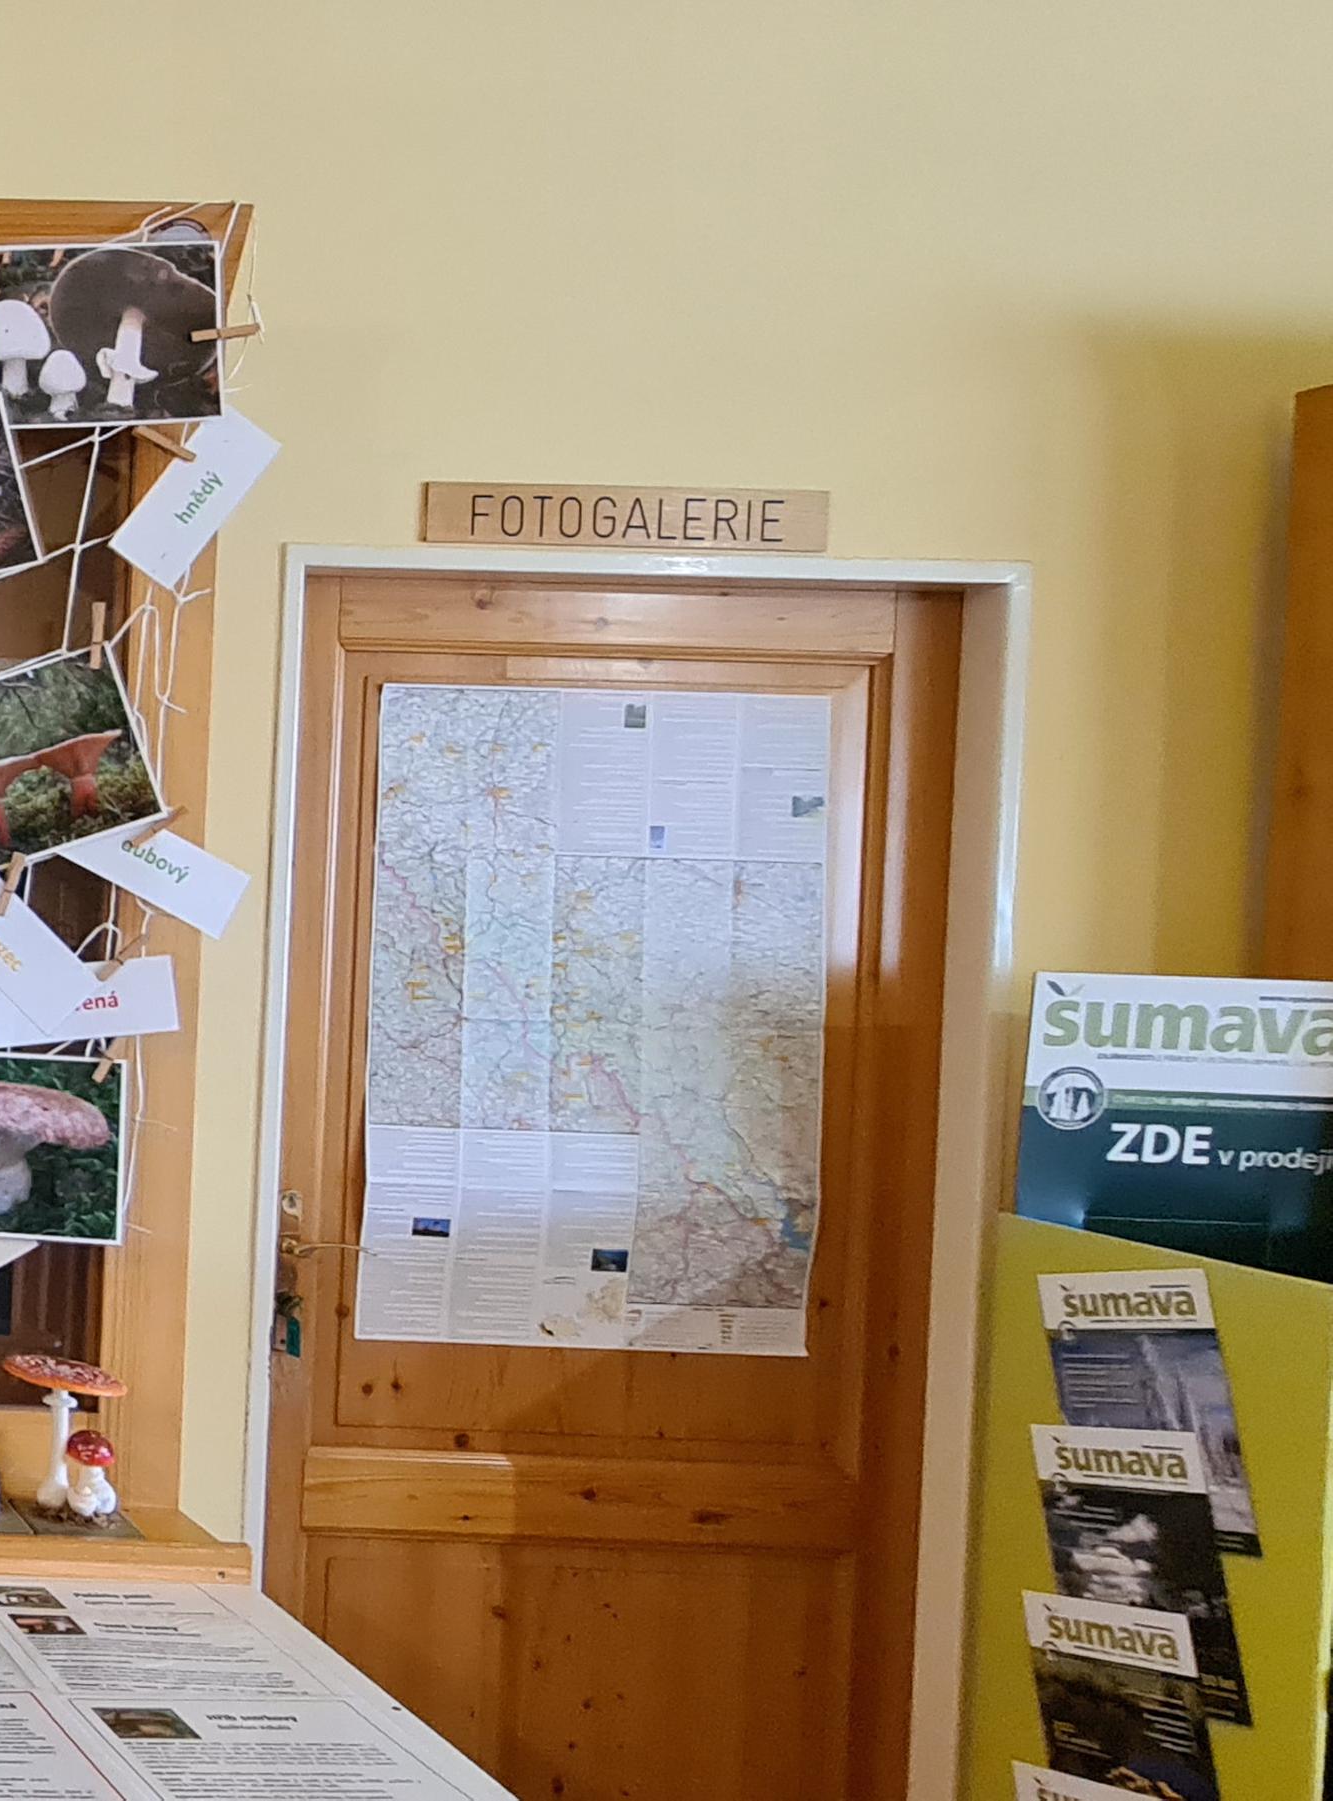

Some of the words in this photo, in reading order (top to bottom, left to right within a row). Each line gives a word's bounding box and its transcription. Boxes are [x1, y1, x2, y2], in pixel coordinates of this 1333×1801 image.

[172, 469, 225, 526] hnědý
[469, 494, 786, 544] FOTOGALERIE
[1042, 979, 1333, 1057] šumava
[1105, 1123, 1213, 1165] ZDE
[1218, 1150, 1235, 1166] v
[1059, 1283, 1197, 1318] šumava
[1052, 1435, 1188, 1481] šumava
[1042, 1603, 1179, 1662] šumava
